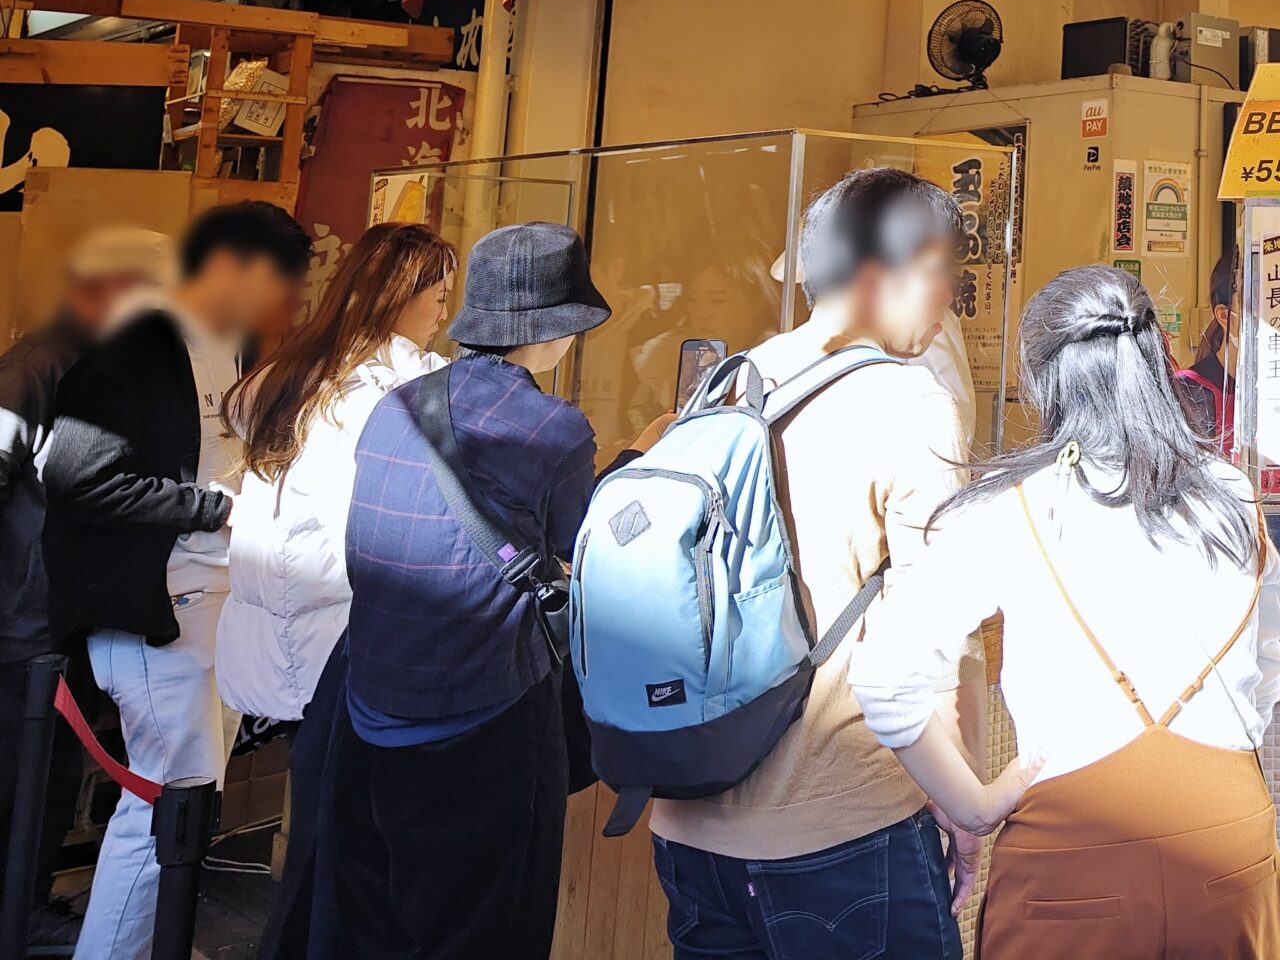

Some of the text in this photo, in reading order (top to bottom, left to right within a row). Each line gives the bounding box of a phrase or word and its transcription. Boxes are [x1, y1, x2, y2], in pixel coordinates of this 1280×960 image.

[1085, 105, 1104, 118] au
[1086, 120, 1103, 132] PAY
[654, 686, 672, 696] NIKE
